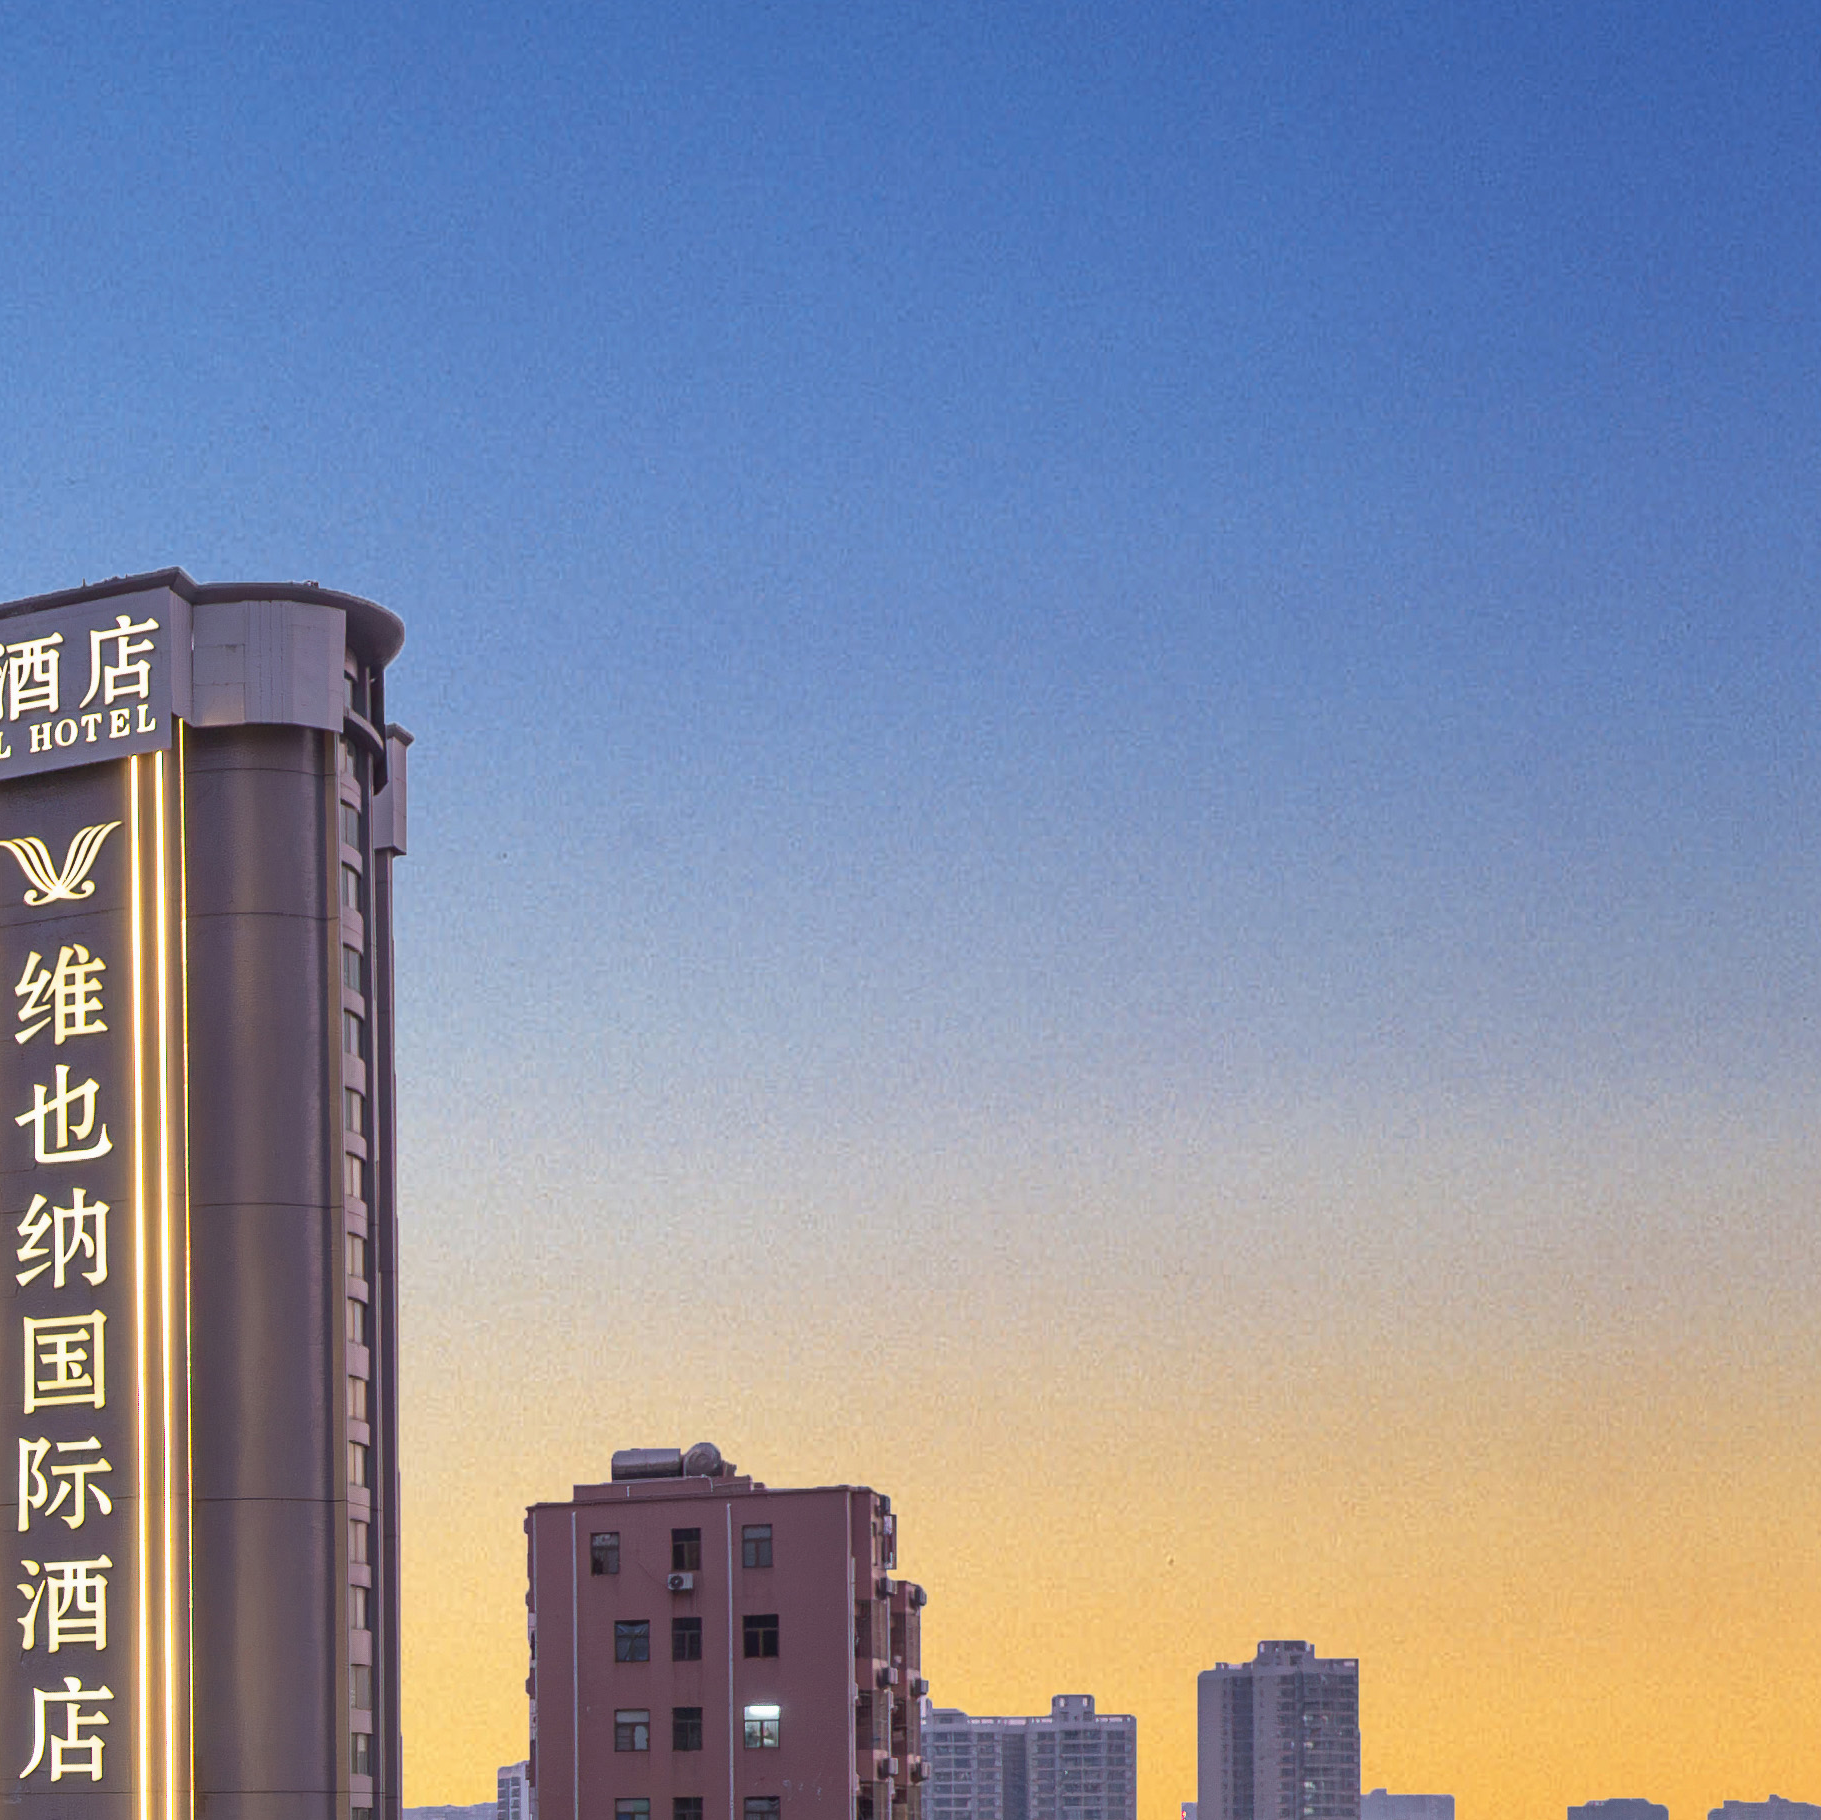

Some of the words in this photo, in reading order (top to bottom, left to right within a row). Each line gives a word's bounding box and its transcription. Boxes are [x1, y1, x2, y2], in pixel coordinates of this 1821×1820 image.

[29, 703, 157, 754] HOTEL
[13, 943, 116, 1783] 维也纳国际酒店
